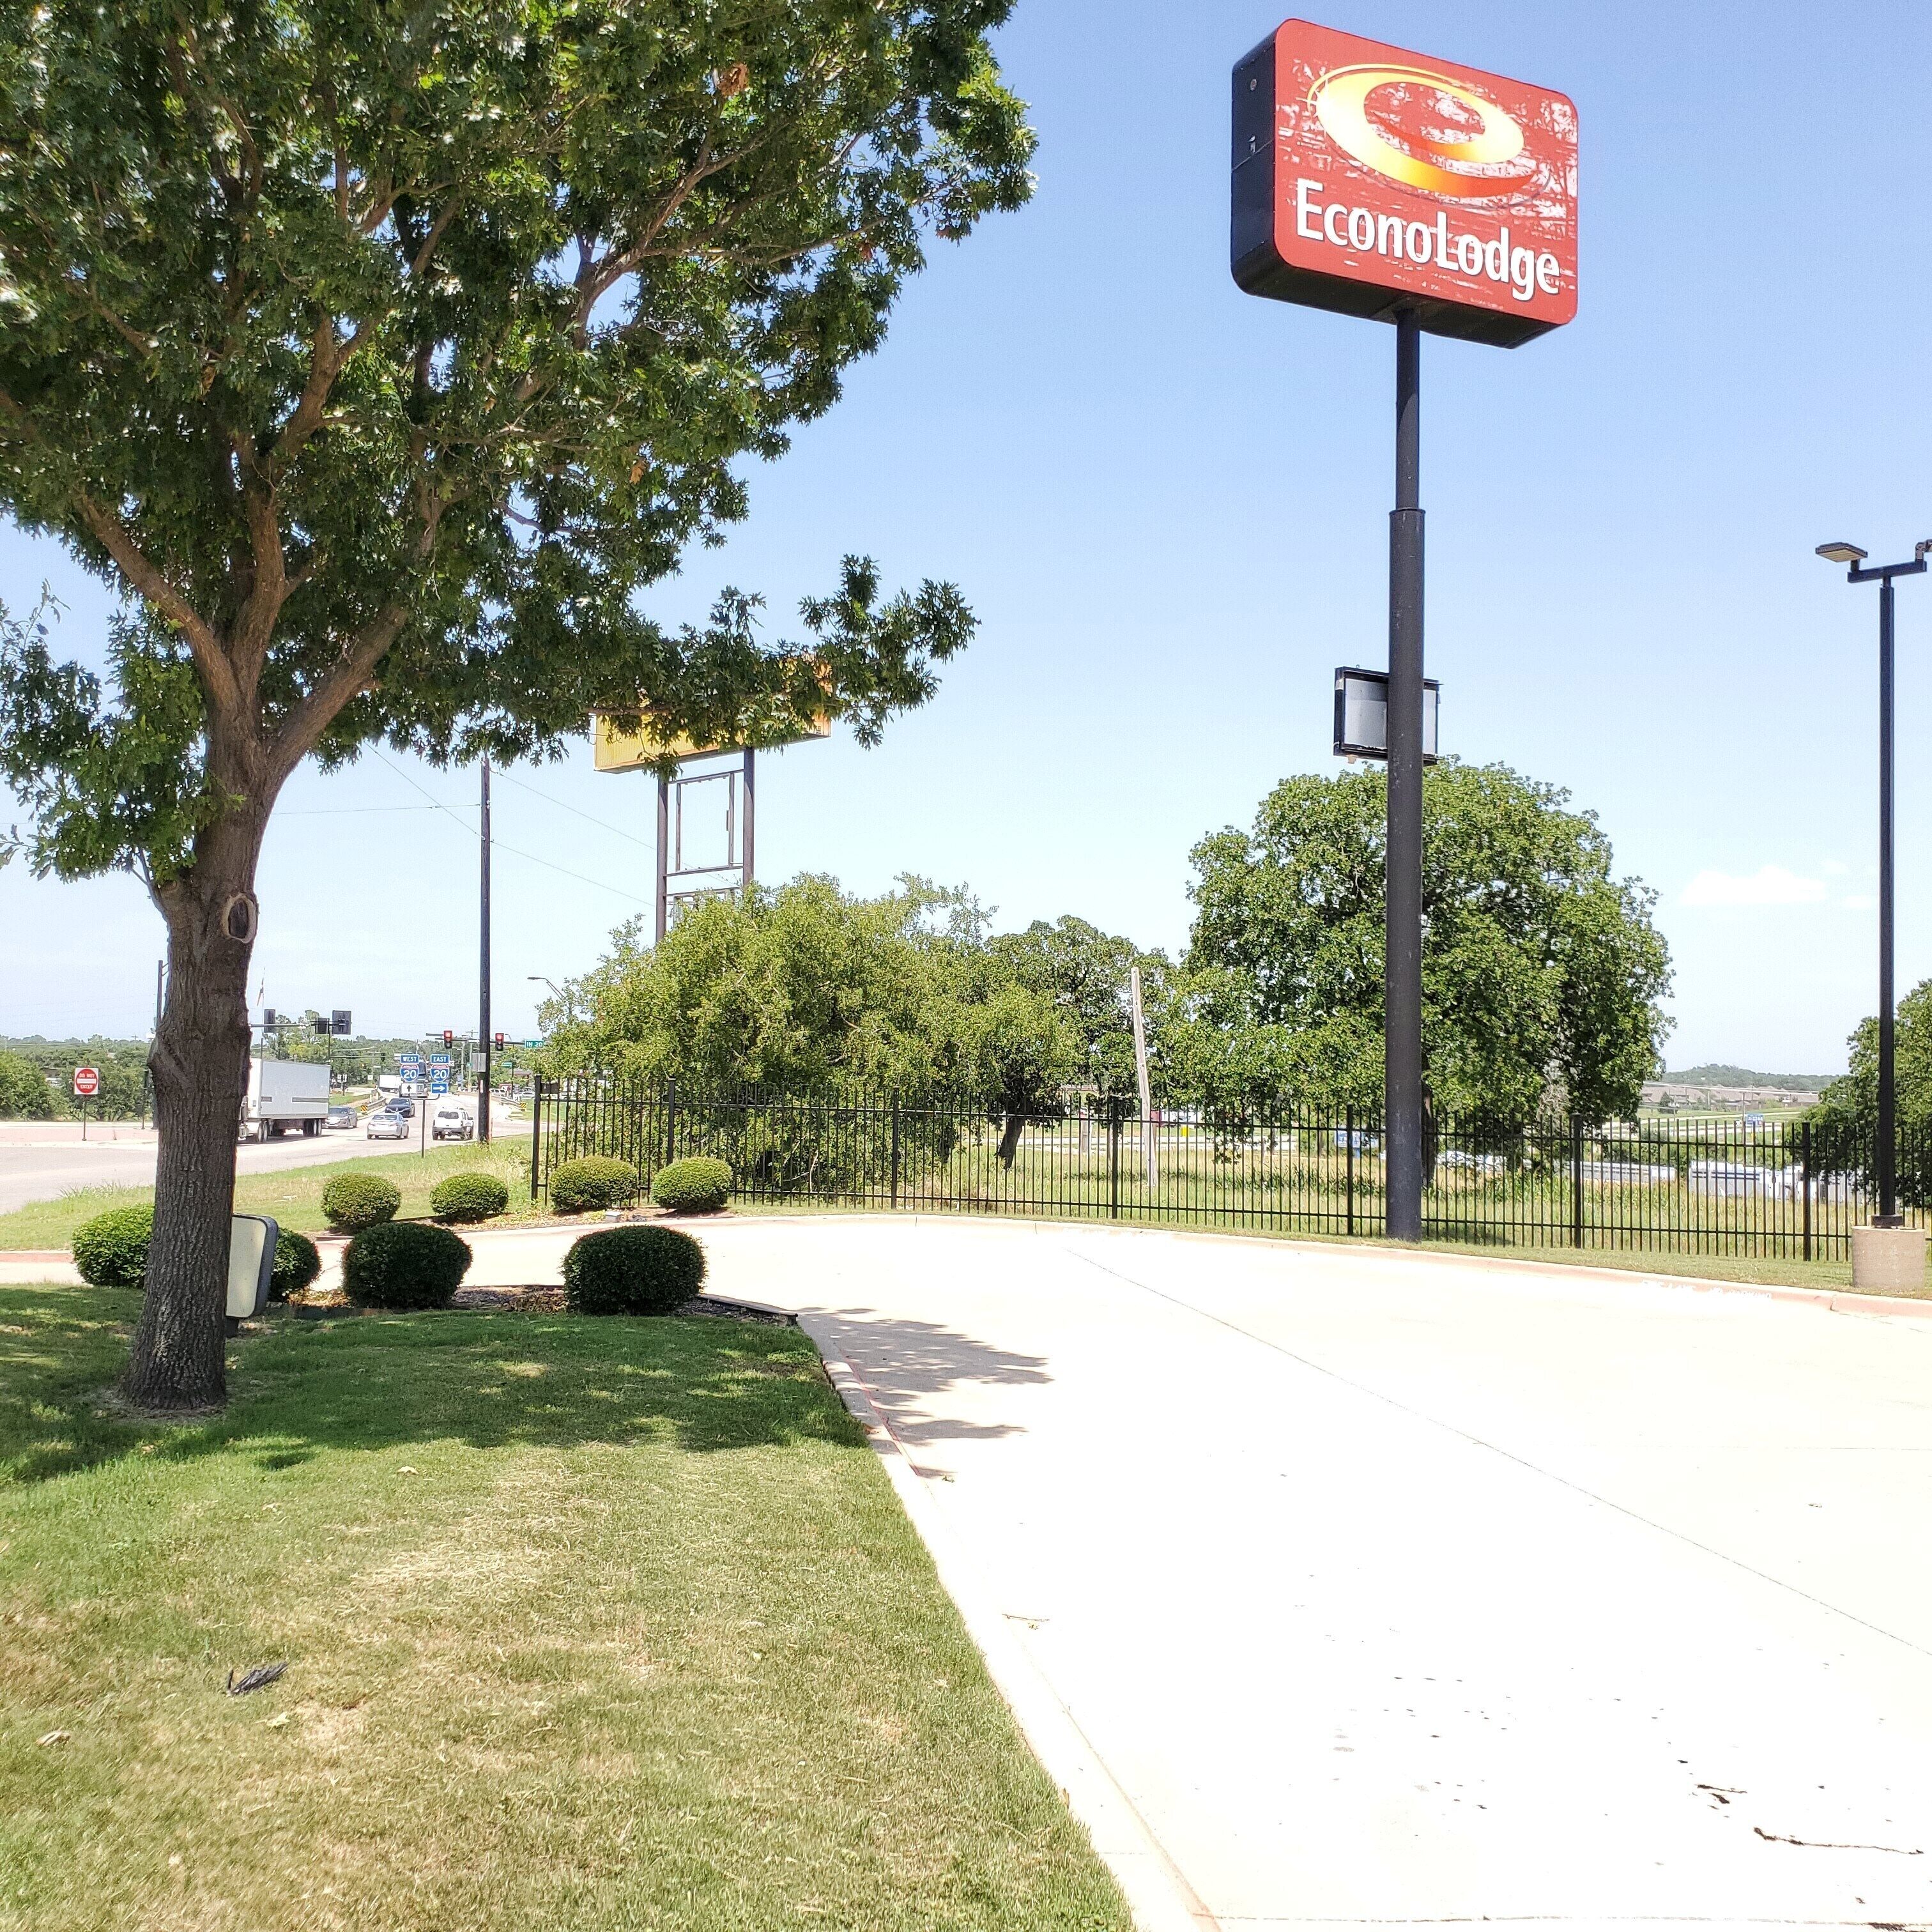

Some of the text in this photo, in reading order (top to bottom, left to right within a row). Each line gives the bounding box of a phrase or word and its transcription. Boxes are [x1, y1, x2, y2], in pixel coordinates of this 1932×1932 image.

[1296, 177, 1560, 302] EconoLodge
[403, 1070, 417, 1079] 20
[434, 1070, 447, 1079] 20
